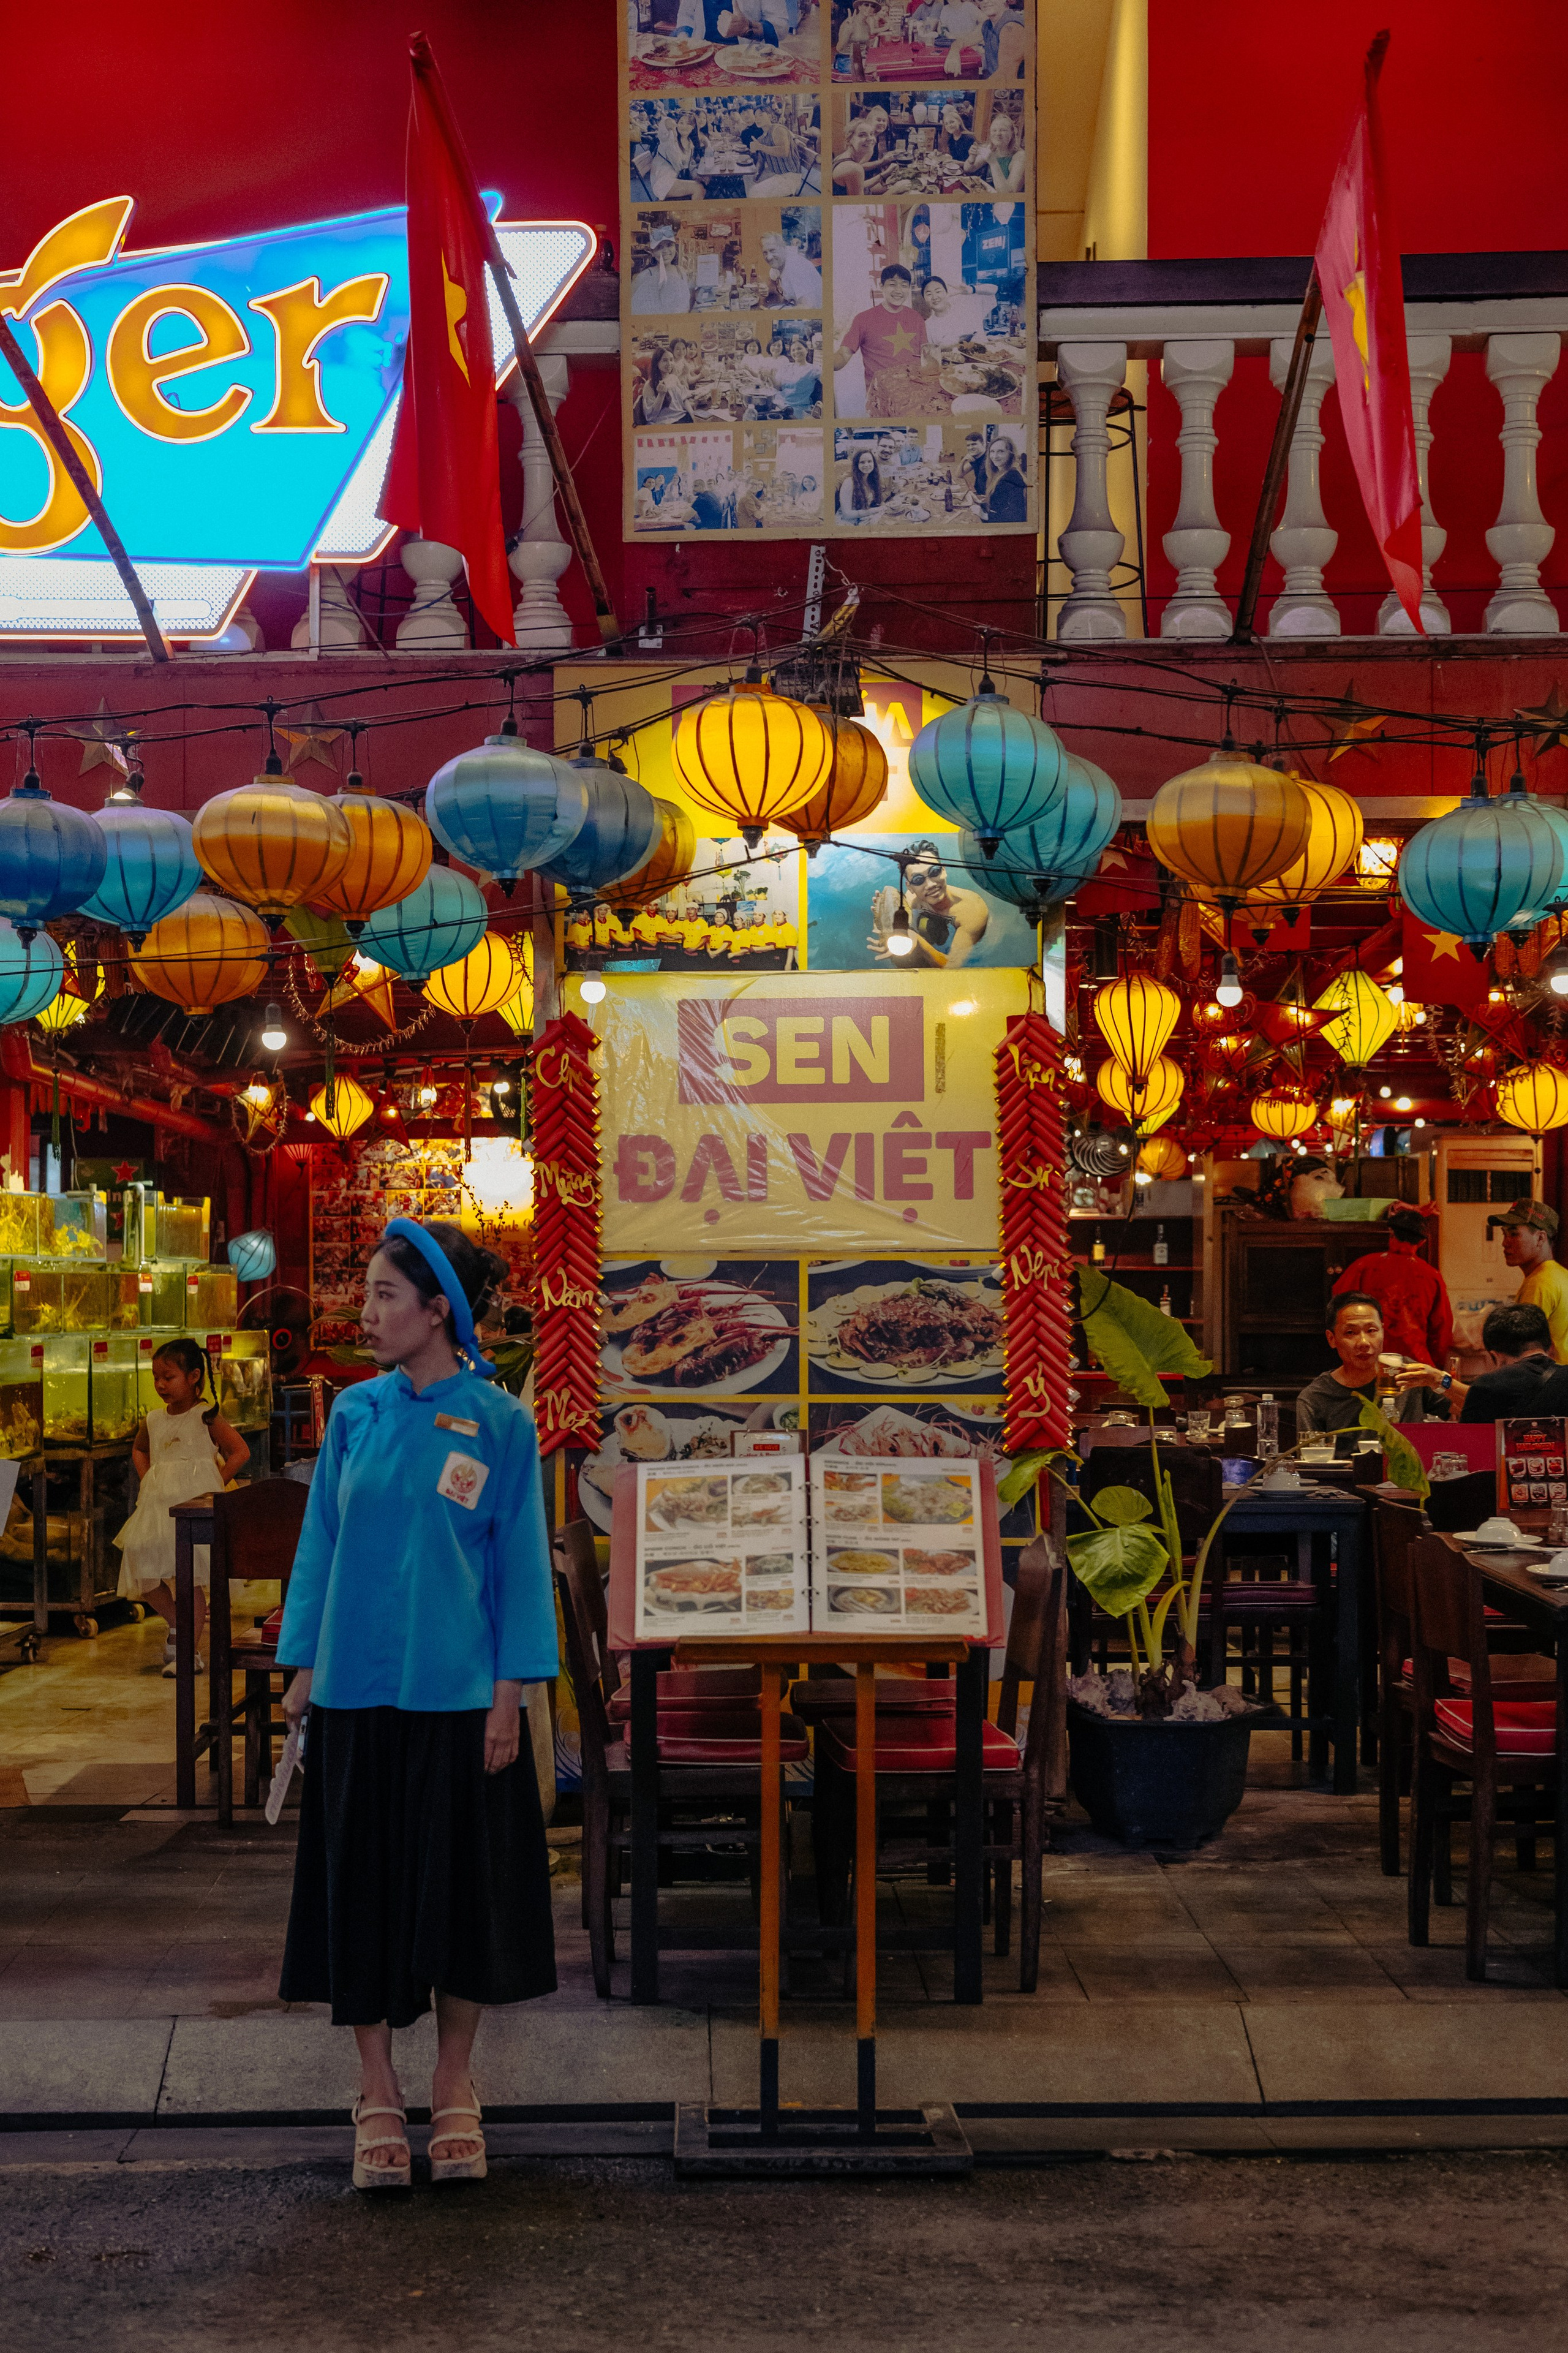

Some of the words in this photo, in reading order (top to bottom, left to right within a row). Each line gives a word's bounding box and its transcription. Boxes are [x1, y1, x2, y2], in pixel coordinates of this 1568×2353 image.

[714, 1016, 889, 1086] SEN
[613, 1133, 767, 1225] ĐẠI
[786, 1110, 992, 1223] VIỆT
